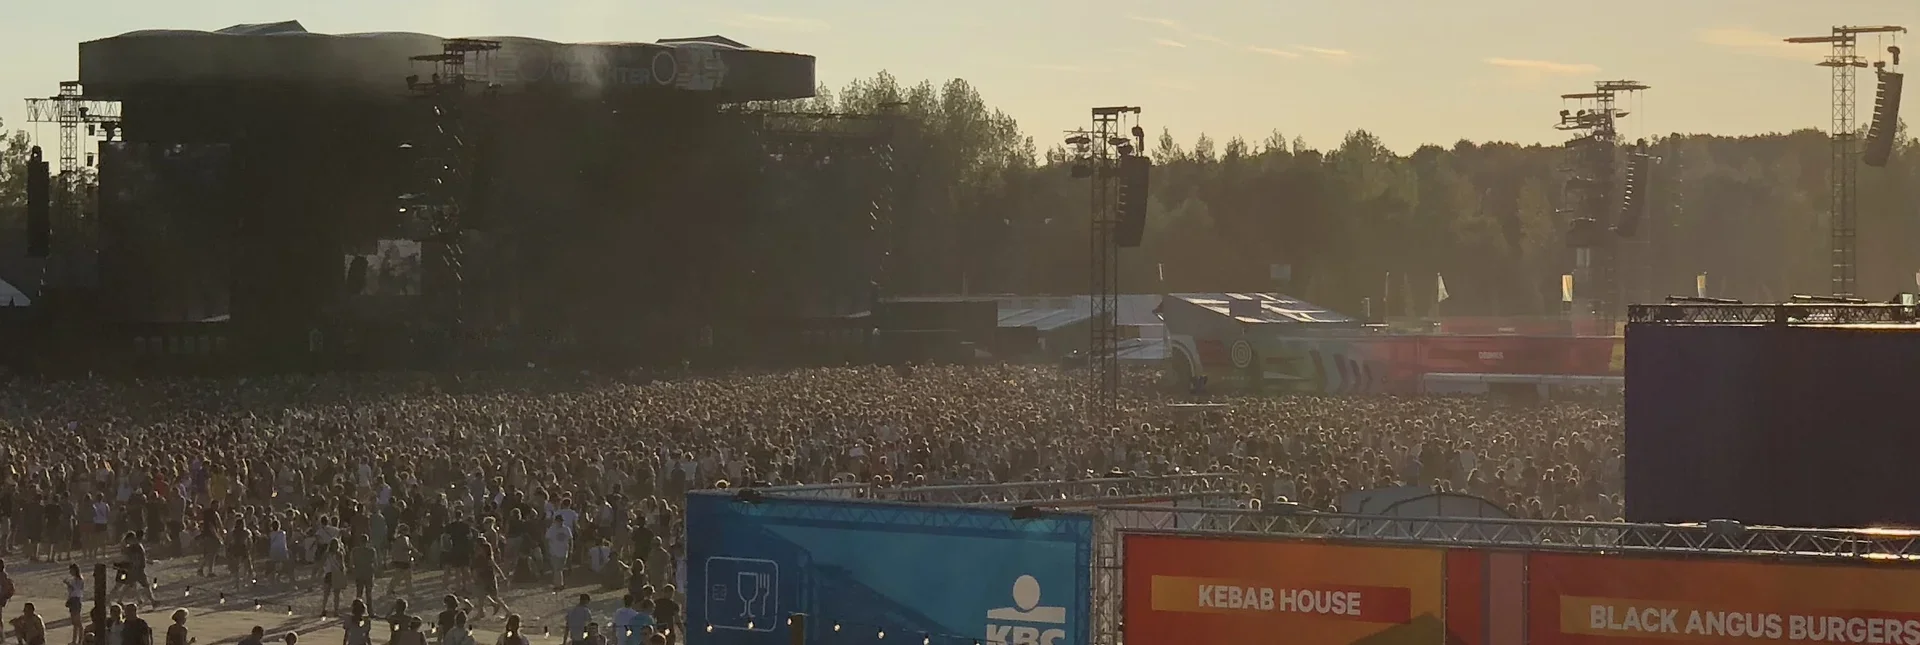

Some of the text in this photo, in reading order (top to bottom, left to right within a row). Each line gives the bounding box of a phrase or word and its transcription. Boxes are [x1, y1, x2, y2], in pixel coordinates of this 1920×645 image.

[1198, 584, 1362, 616] KEBAB HOUSE
[986, 623, 1066, 645] KBC
[1589, 605, 1920, 645] BLACK ANGUS BURGERS
